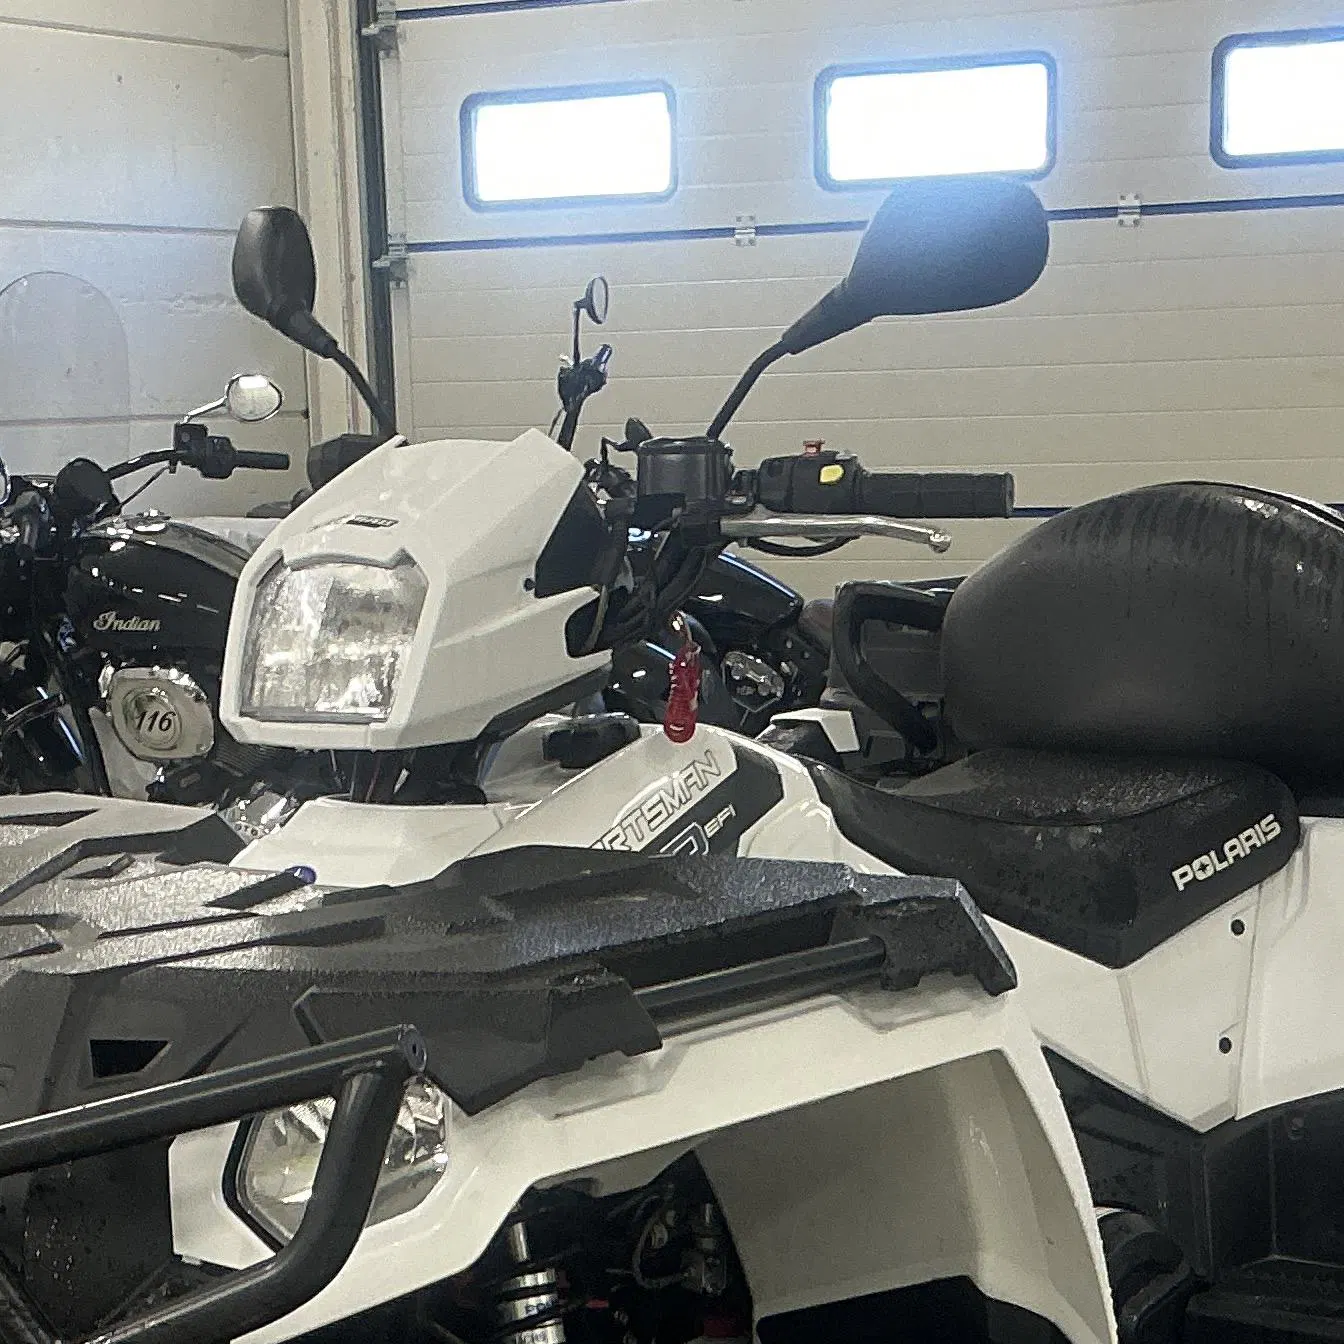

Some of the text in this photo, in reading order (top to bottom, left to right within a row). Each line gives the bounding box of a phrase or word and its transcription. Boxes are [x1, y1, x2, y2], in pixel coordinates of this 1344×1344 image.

[93, 610, 161, 632] Indian
[137, 710, 177, 732] 116
[592, 749, 722, 851] RTSMAN
[703, 803, 737, 839] EFI
[1171, 813, 1282, 892] POLARIS
